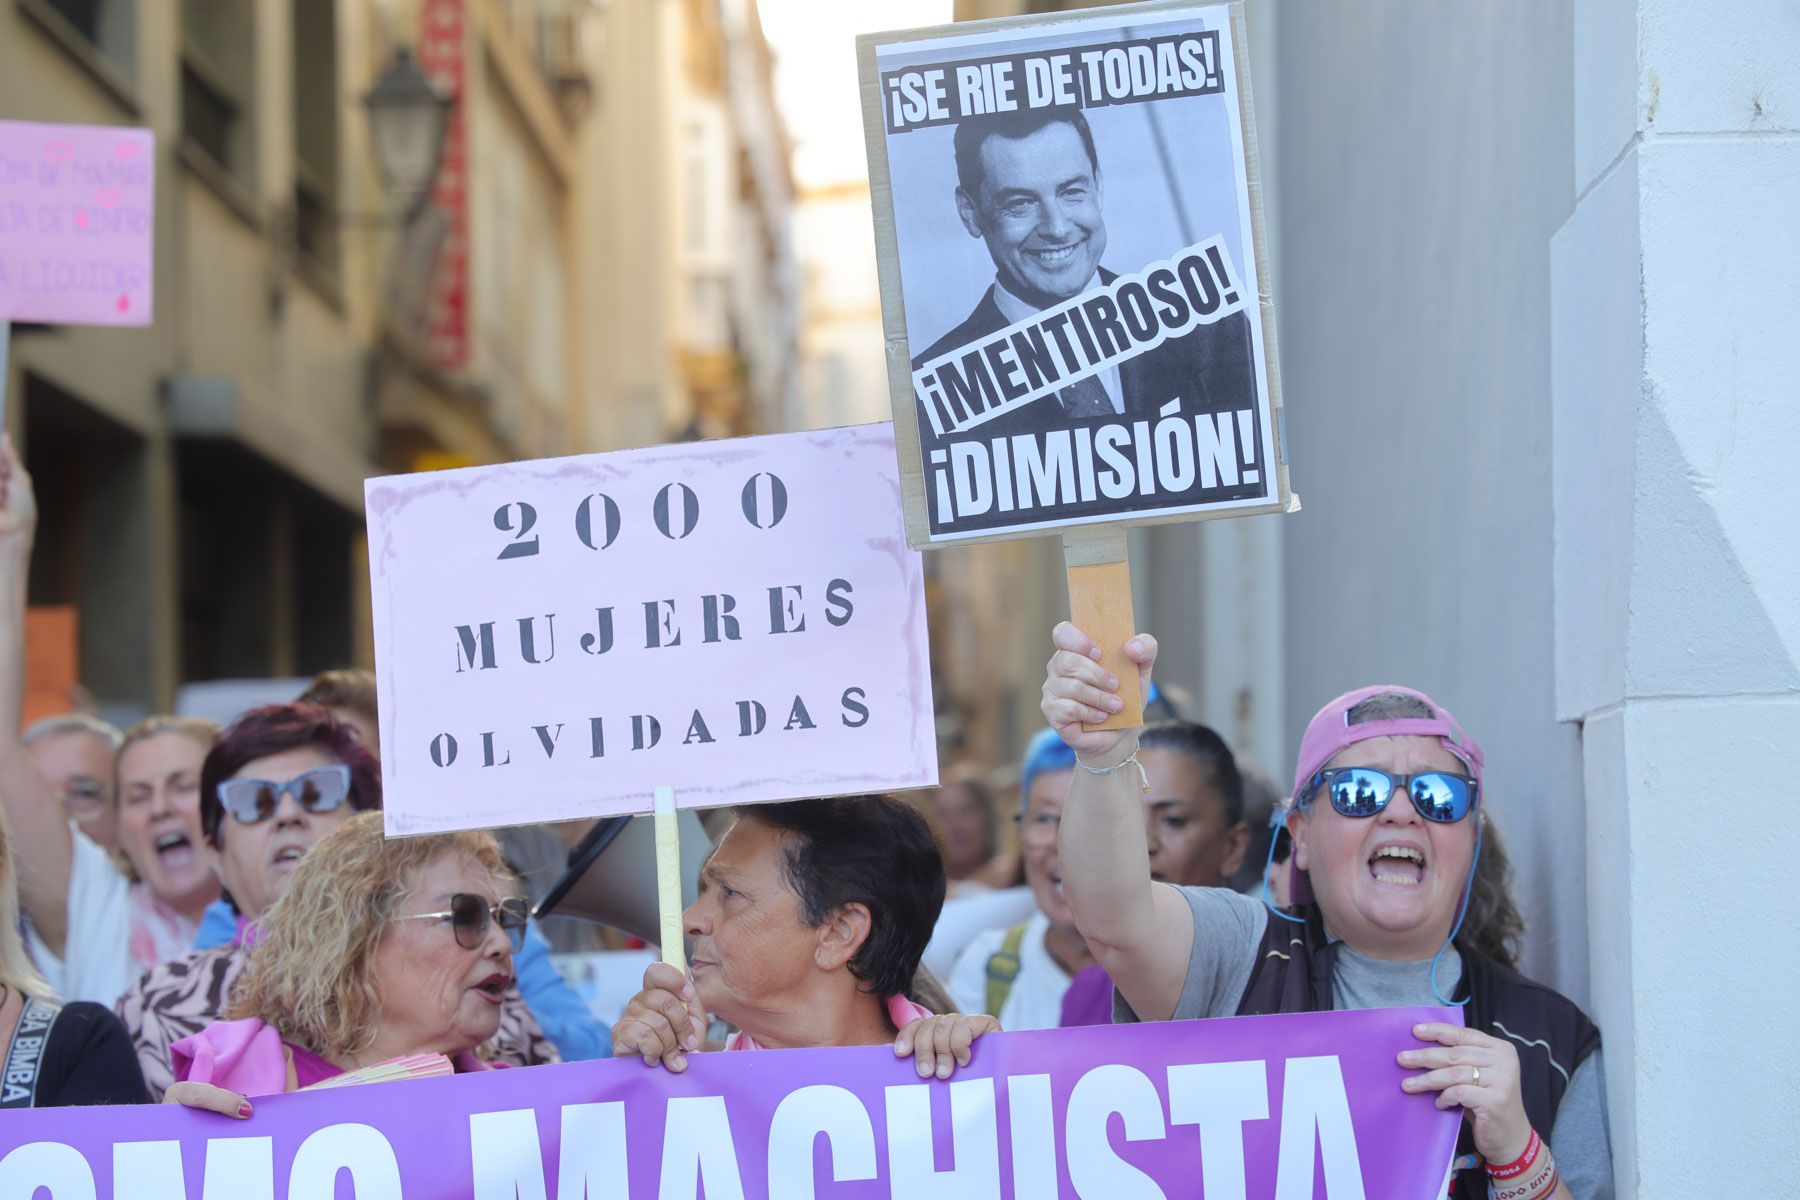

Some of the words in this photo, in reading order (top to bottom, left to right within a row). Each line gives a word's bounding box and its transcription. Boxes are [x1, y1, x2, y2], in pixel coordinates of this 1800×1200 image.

[889, 68, 949, 128] ¡SE
[956, 61, 1020, 117] RIE
[1024, 54, 1078, 110] DE
[1081, 37, 1218, 104] TODAS!
[921, 244, 1240, 435] ¡MENTIROSO!
[930, 396, 1260, 525] ¡DIMISIÓN!
[493, 471, 788, 560] 2000
[454, 578, 853, 673] MUJERES
[429, 686, 870, 768] OLVIDADAS
[1, 1036, 43, 1104] BIMBA
